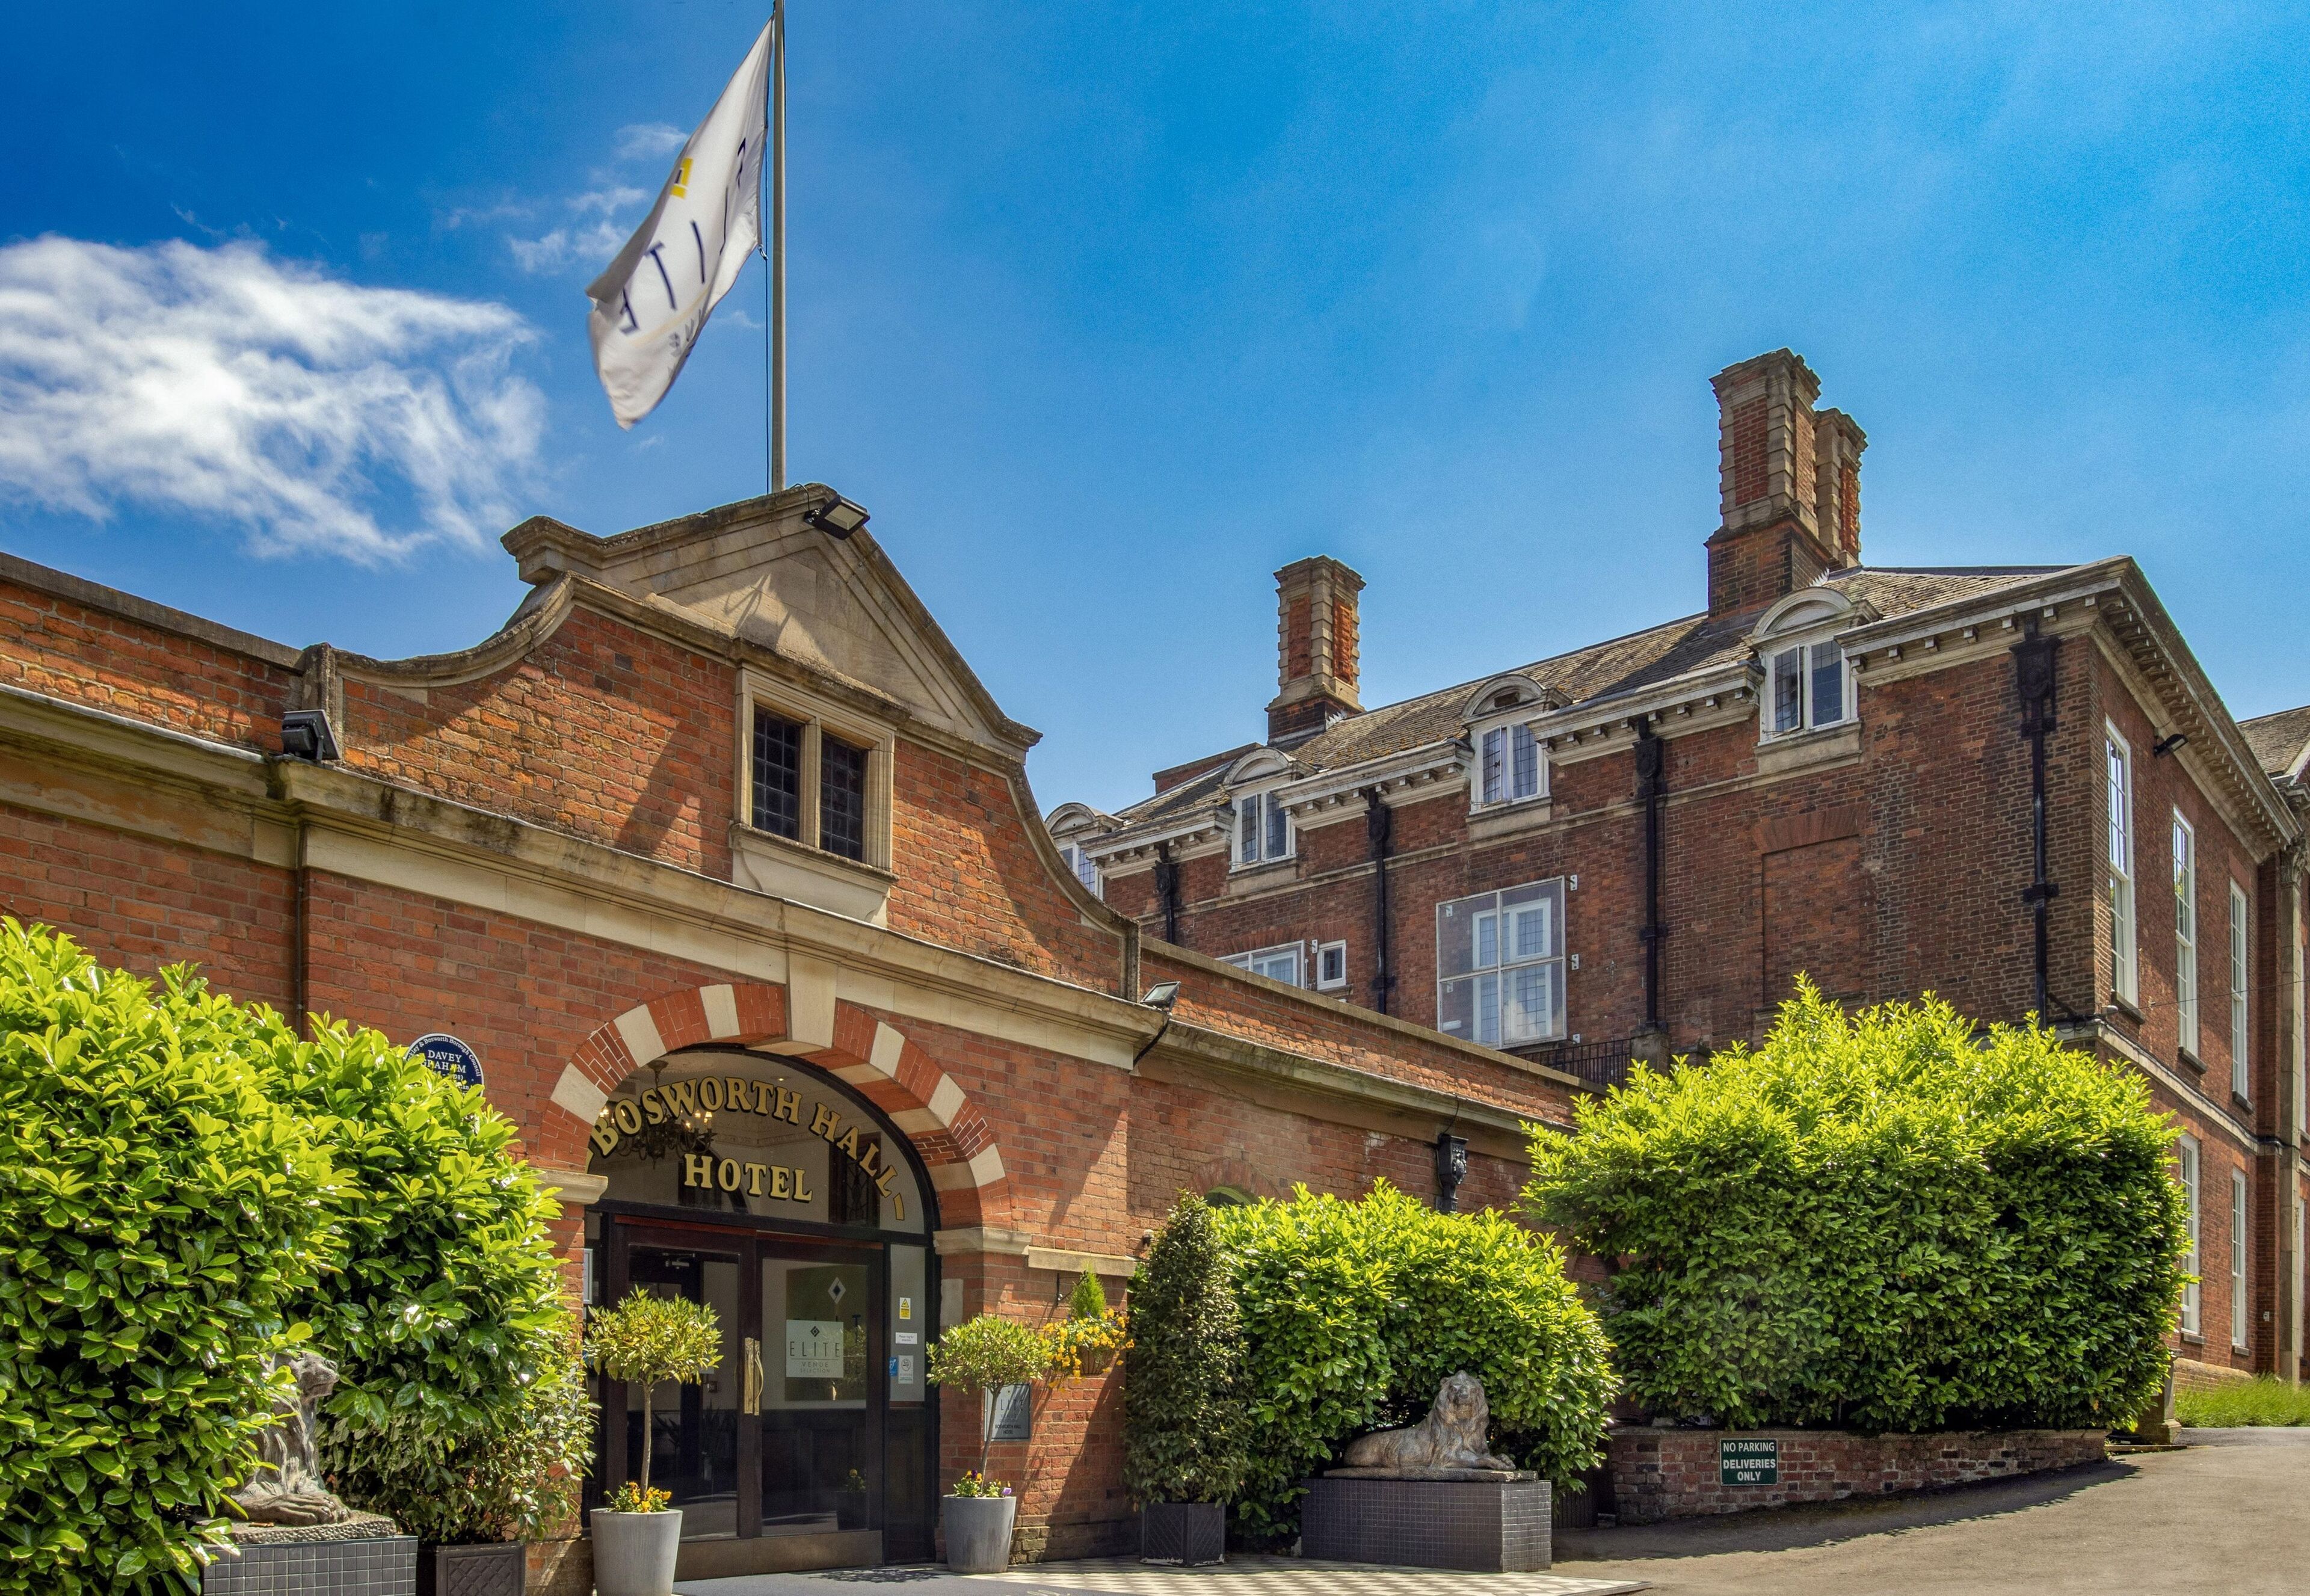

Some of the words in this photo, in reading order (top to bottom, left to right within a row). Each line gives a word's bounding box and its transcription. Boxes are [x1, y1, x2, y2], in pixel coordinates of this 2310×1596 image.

[428, 1050, 462, 1063] DAVEY
[449, 1038, 469, 1055] Borough
[469, 1054, 482, 1077] Council
[421, 1059, 466, 1073] GRAHM
[591, 1076, 802, 1158] BOSWORTH
[809, 1102, 898, 1198] HALL
[683, 1153, 813, 1203] HOTEL
[790, 1341, 840, 1358] ELITE
[1000, 1399, 1024, 1411] LITE
[1723, 1443, 1736, 1452] NO
[1738, 1442, 1775, 1452] PARKING
[1723, 1458, 1776, 1469] DELIVERIES
[1737, 1471, 1761, 1481] ONLY
